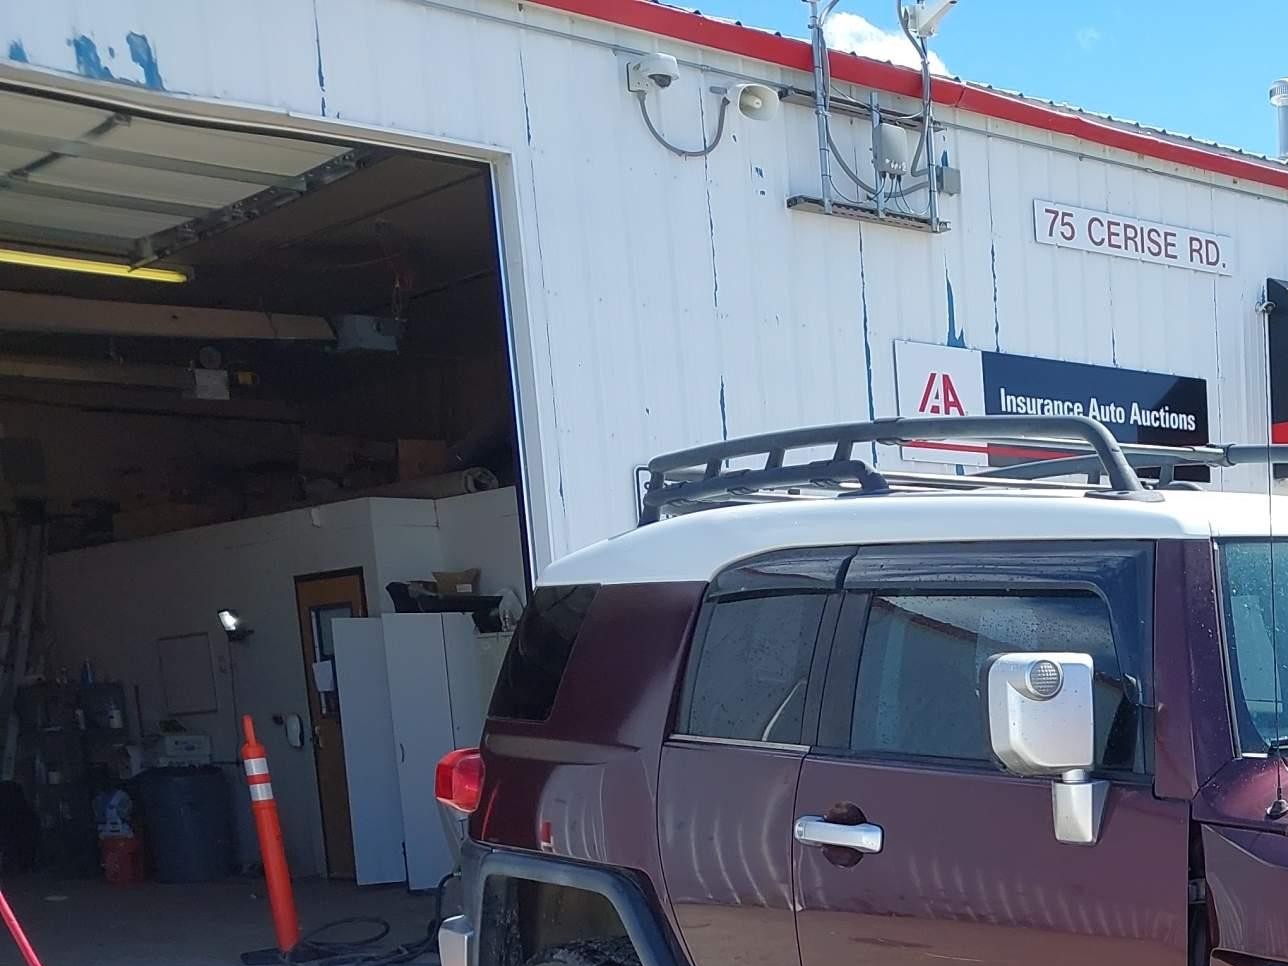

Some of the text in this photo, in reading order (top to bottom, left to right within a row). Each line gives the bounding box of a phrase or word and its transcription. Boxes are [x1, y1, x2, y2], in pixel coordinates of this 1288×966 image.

[1044, 207, 1226, 269] 75 CERISE RD.
[1000, 387, 1196, 432] Insurance Auto Auctions
